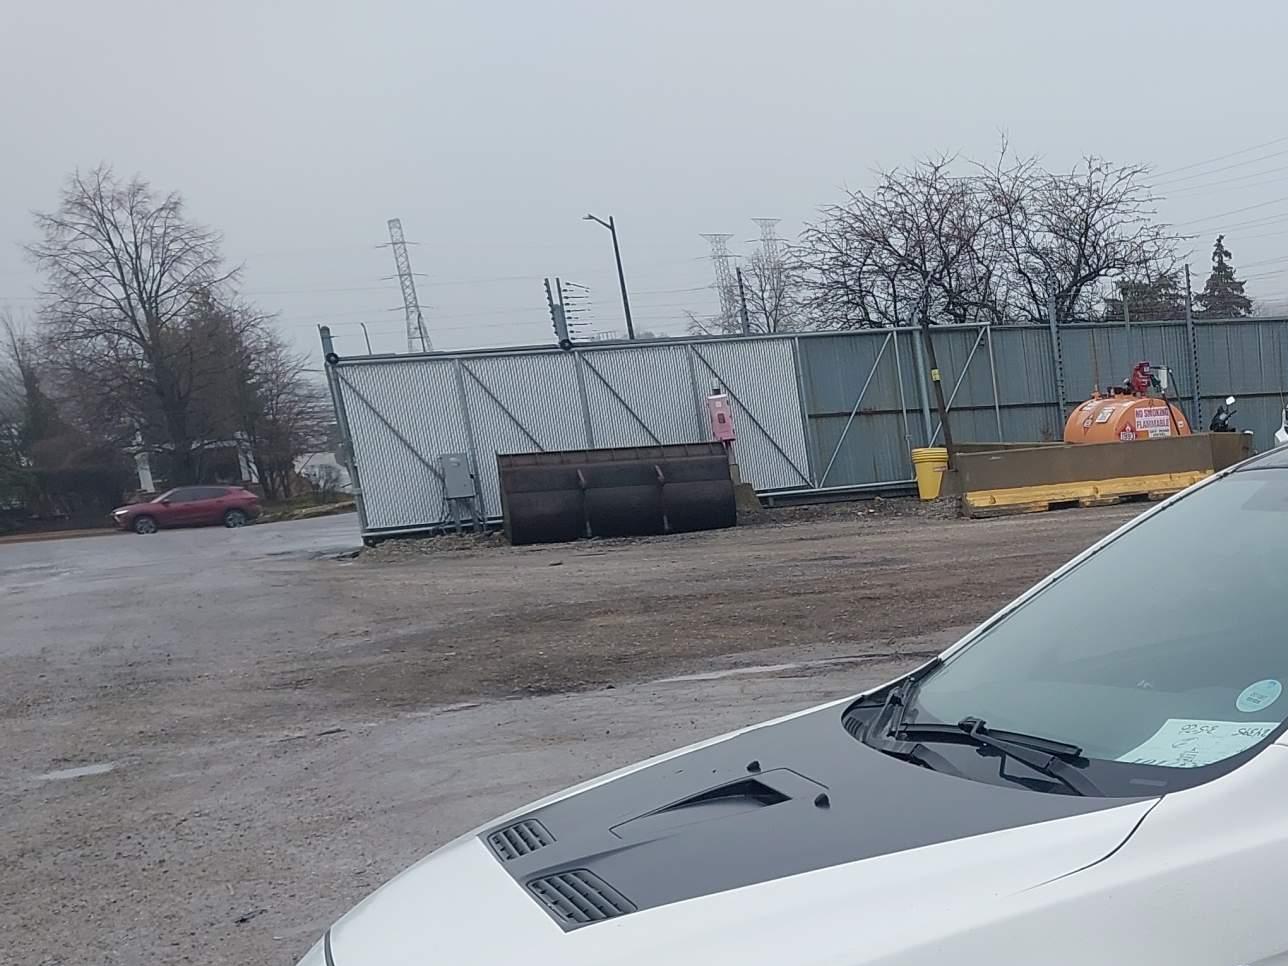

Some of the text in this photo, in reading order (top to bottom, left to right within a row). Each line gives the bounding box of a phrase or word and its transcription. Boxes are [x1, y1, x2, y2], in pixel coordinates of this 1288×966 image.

[1136, 408, 1169, 418] NO SMOKING
[1136, 419, 1169, 430] FLAMMABLE
